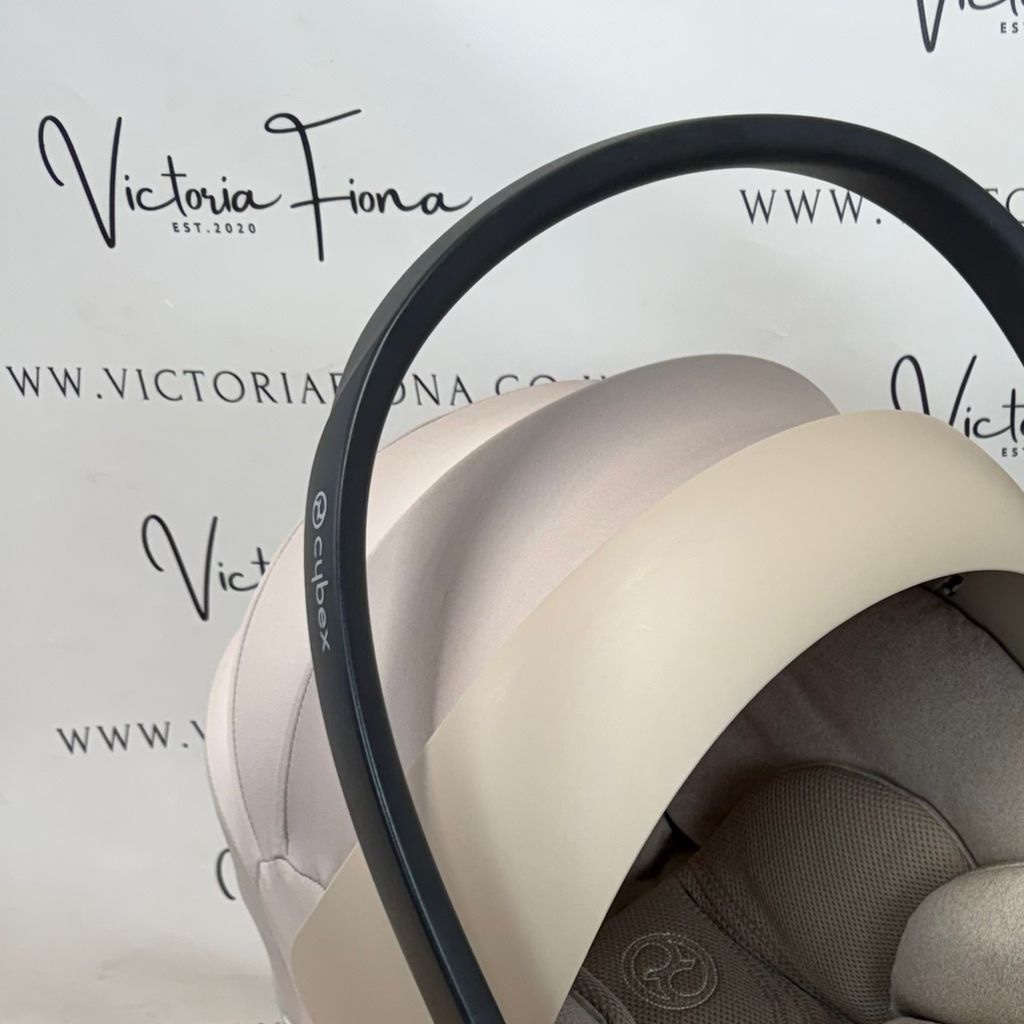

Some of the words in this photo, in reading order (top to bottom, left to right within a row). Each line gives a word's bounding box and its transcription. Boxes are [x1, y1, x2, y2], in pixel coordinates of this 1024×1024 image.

[38, 115, 282, 249] Victoria
[264, 109, 473, 262] Fiona
[172, 222, 257, 234] EST.2020
[311, 536, 330, 651] cybex
